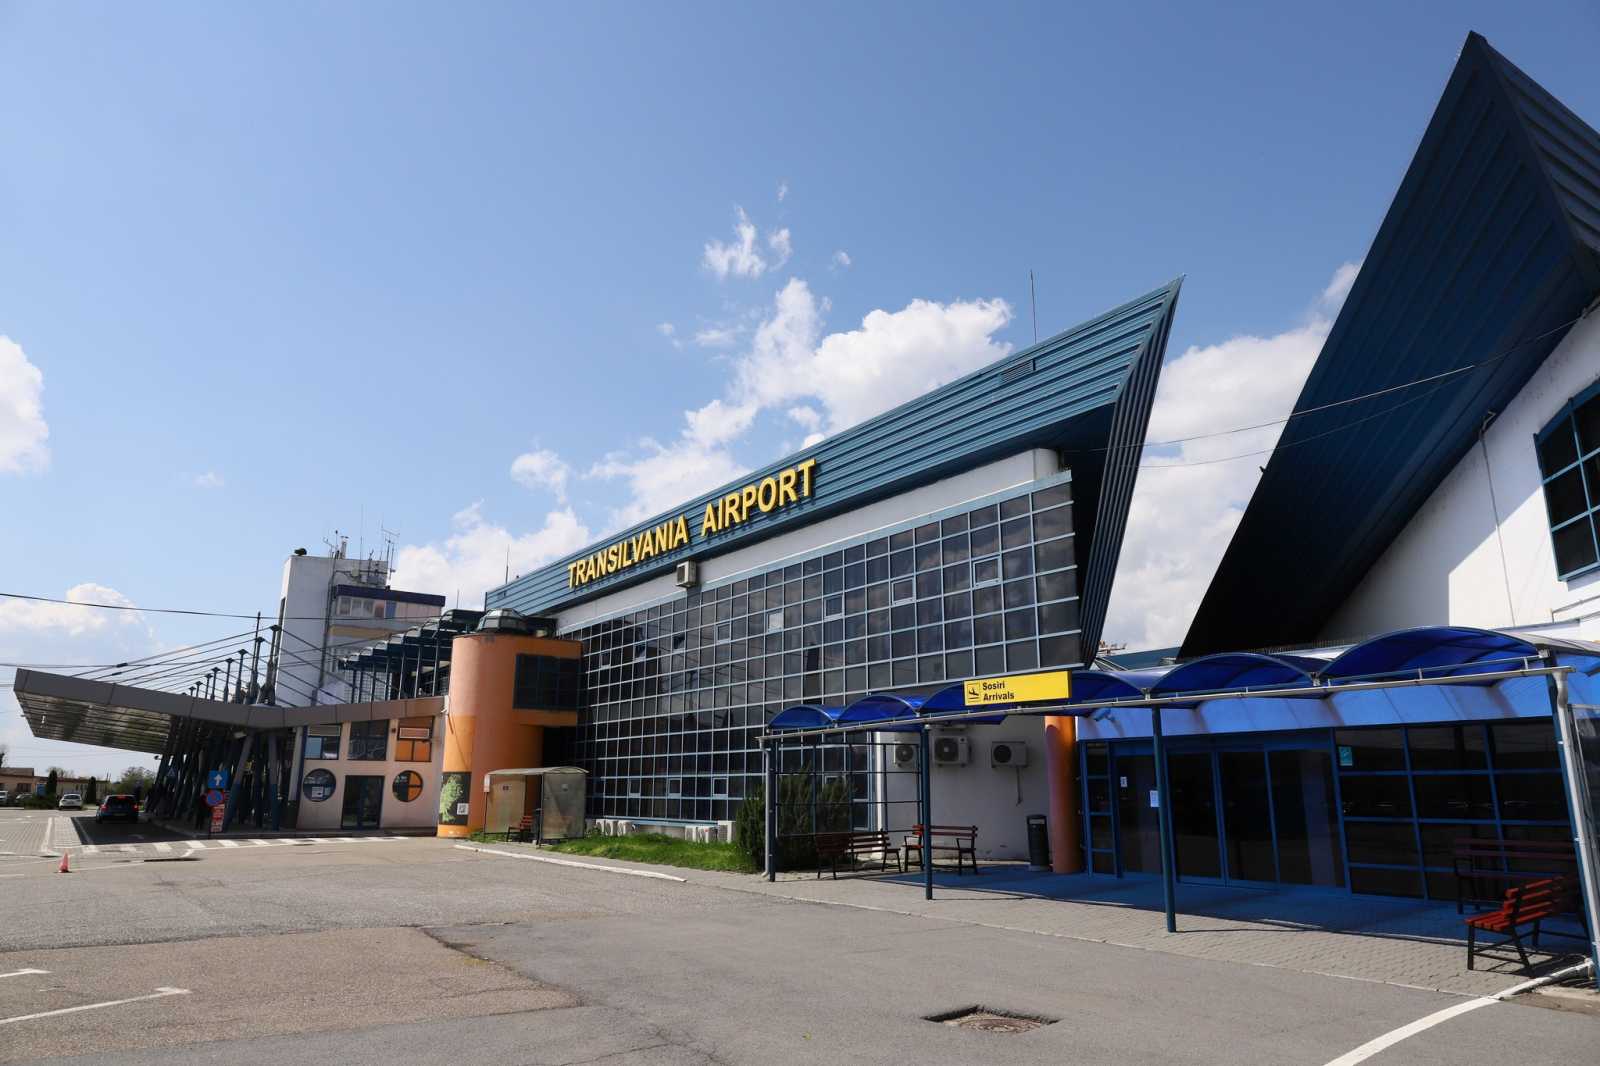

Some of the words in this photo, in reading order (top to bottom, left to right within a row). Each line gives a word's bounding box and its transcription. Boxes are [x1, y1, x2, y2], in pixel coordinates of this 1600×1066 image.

[567, 514, 689, 589] TRANSILVANIA
[701, 458, 816, 537] AIRPORT
[982, 681, 1005, 691] Sosiri
[983, 691, 1015, 701] Arrivals
